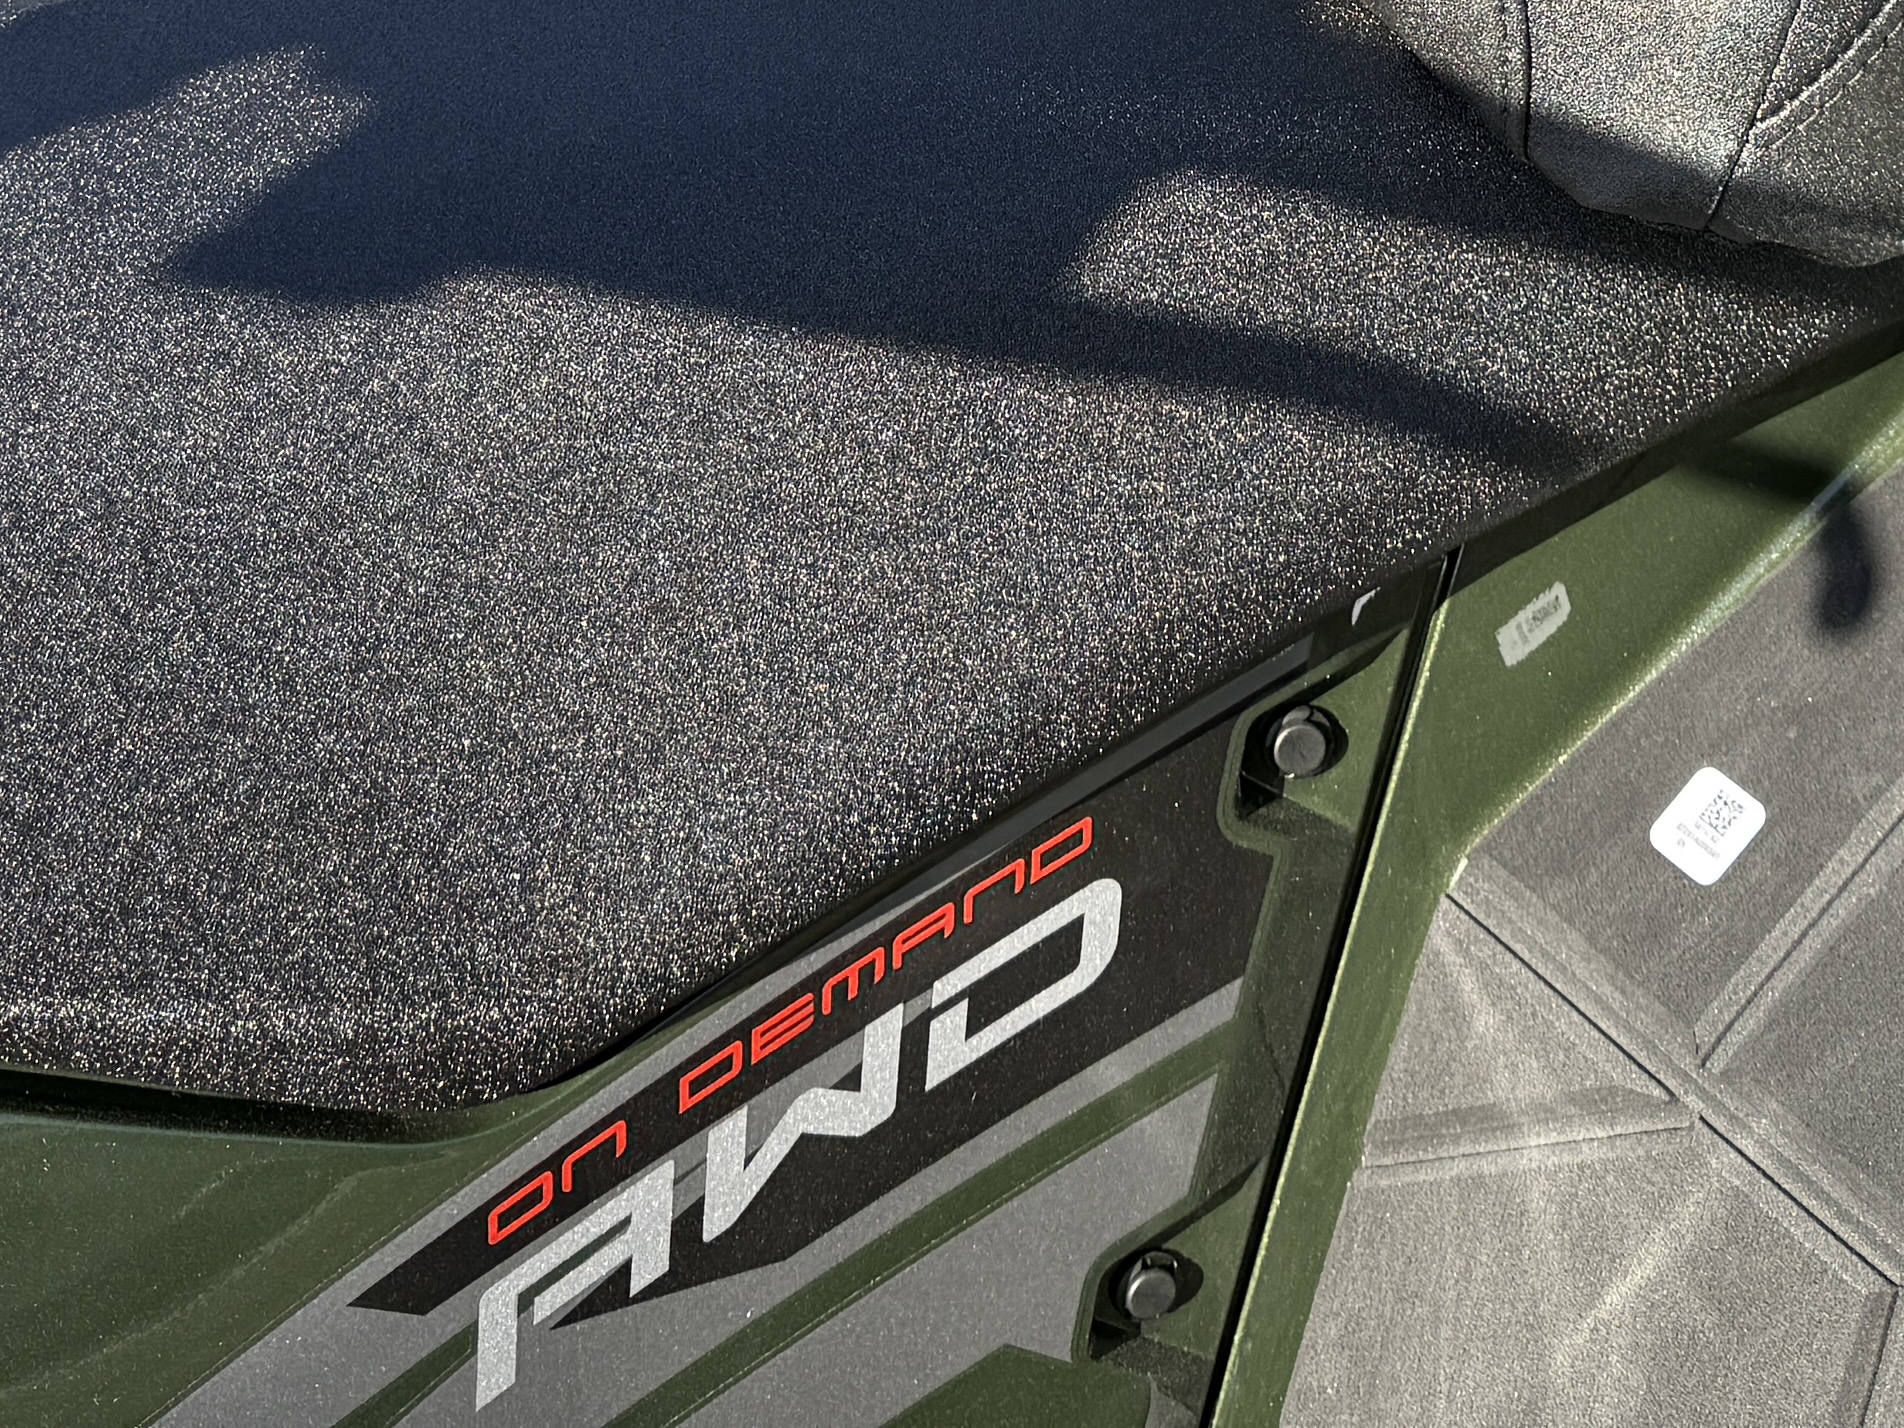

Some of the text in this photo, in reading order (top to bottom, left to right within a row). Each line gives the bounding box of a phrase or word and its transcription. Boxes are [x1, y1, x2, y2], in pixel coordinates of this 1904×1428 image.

[475, 877, 1123, 1411] AWD
[487, 817, 1094, 1246] ON DEMAND
